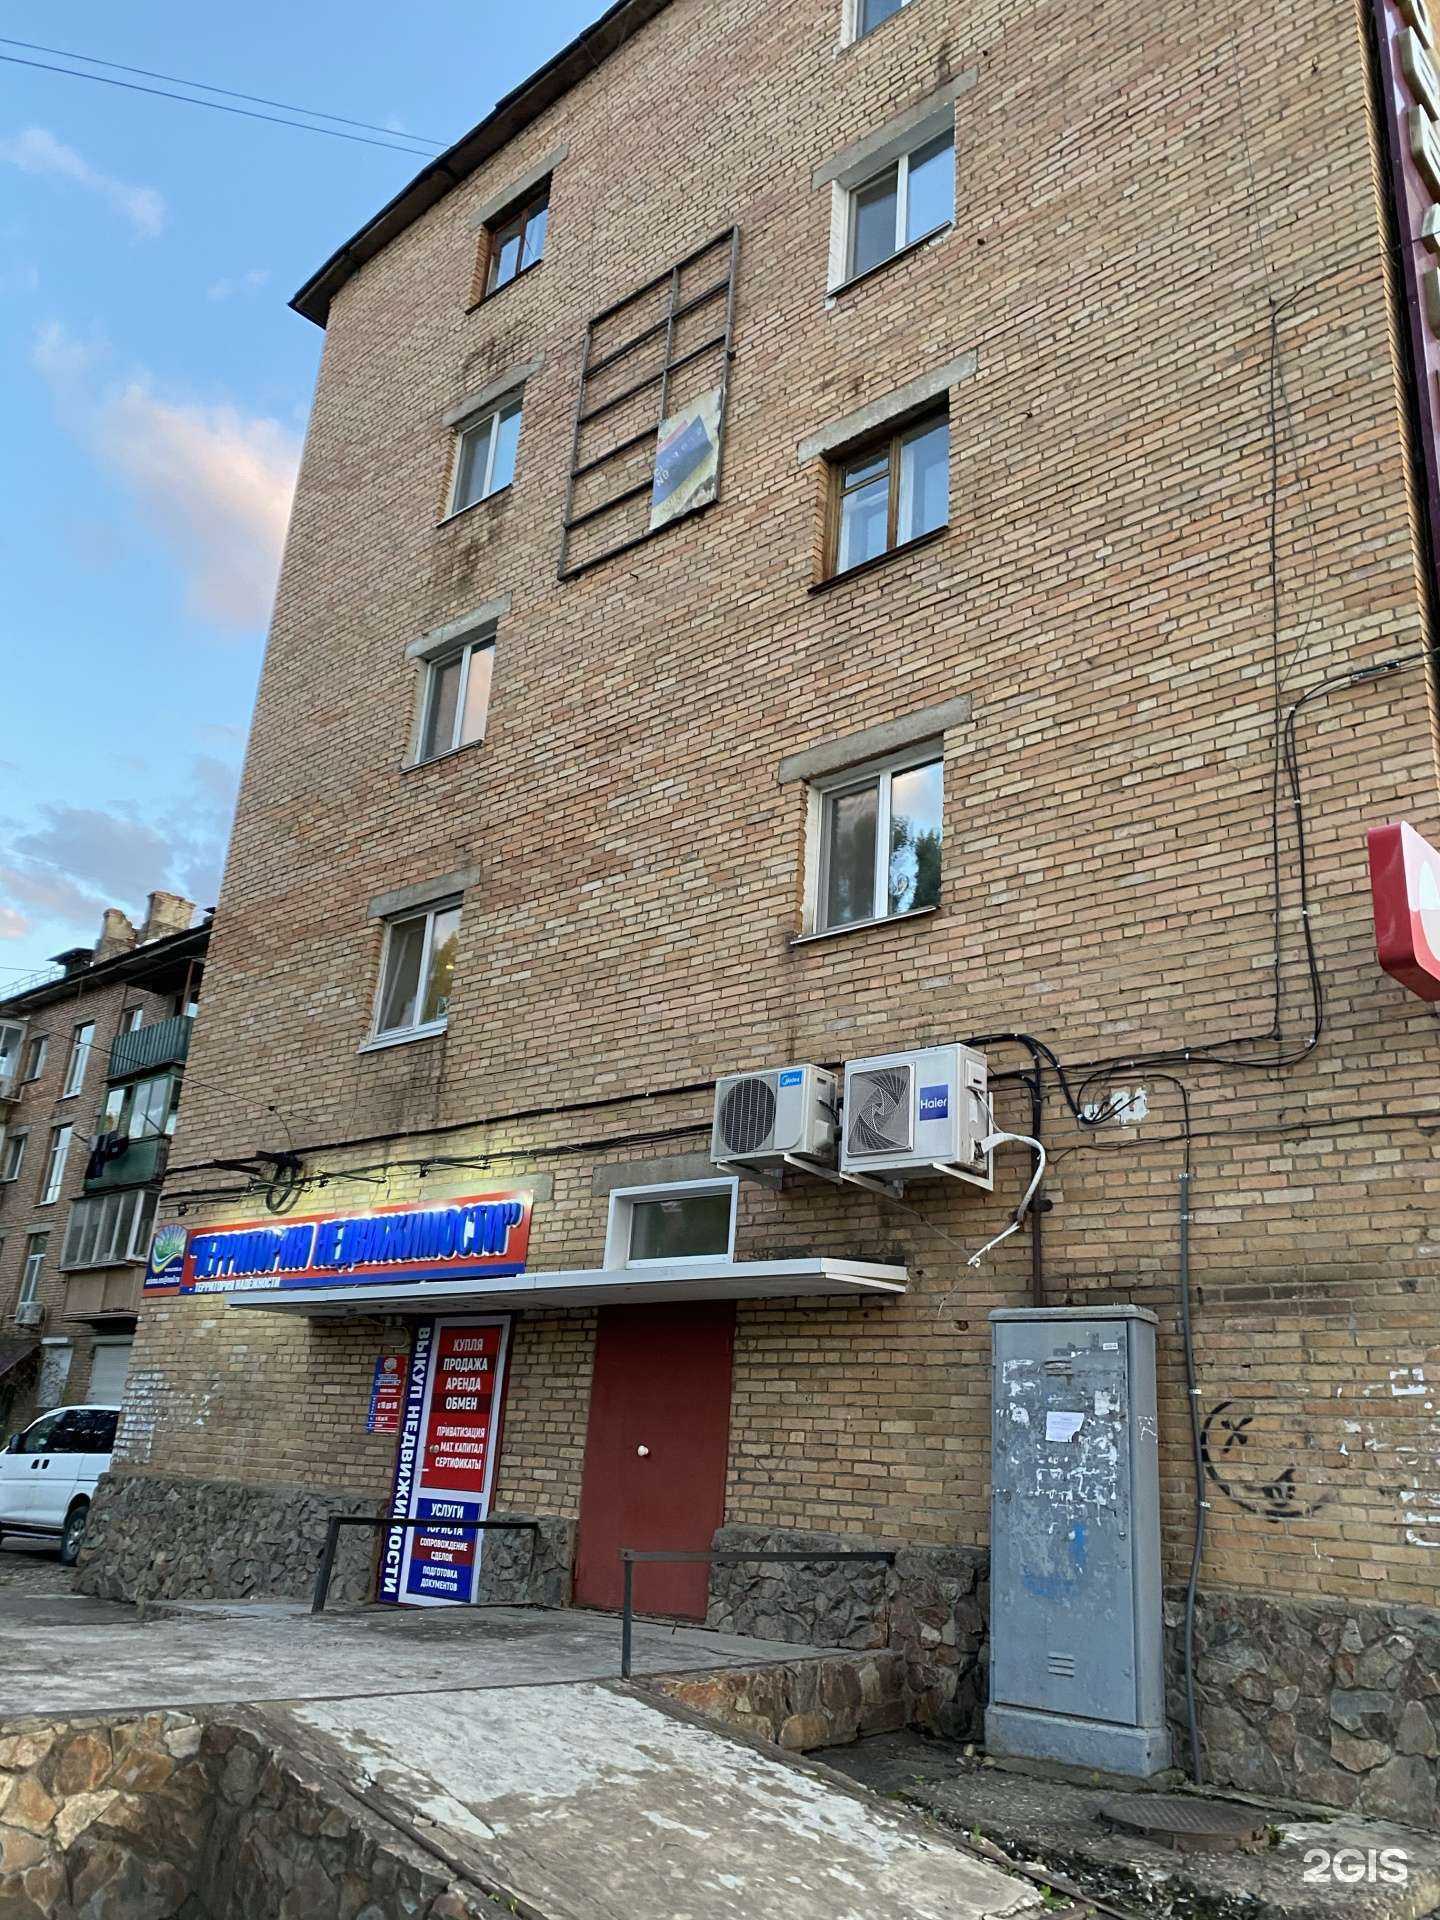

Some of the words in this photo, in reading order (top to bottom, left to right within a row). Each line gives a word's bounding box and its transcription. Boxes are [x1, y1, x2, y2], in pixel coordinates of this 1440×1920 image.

[920, 1097, 948, 1110] Haier
[453, 1338, 484, 1352] КУПЛЯ
[409, 1327, 430, 1398] ВЫКУП
[443, 1358, 488, 1372] ПРОДАЖА
[445, 1377, 481, 1392] АРЕНДА
[445, 1396, 478, 1410] ОБМЕН
[436, 1426, 486, 1439] ПРИВАТИЗАЦИЯ
[435, 1457, 482, 1470] СЕРТИФИКАТЫ
[383, 1406, 420, 1593] НЕДВИЖИМОСТИ
[431, 1503, 464, 1519] УСЛУГИ
[420, 1537, 468, 1552] СОПРОВОЖДЕНИЕ
[430, 1551, 453, 1562] СДЕЛОК
[422, 1565, 458, 1579] ПОДГОТОВКА
[420, 1578, 458, 1592] ДОКУМЕНТОВ
